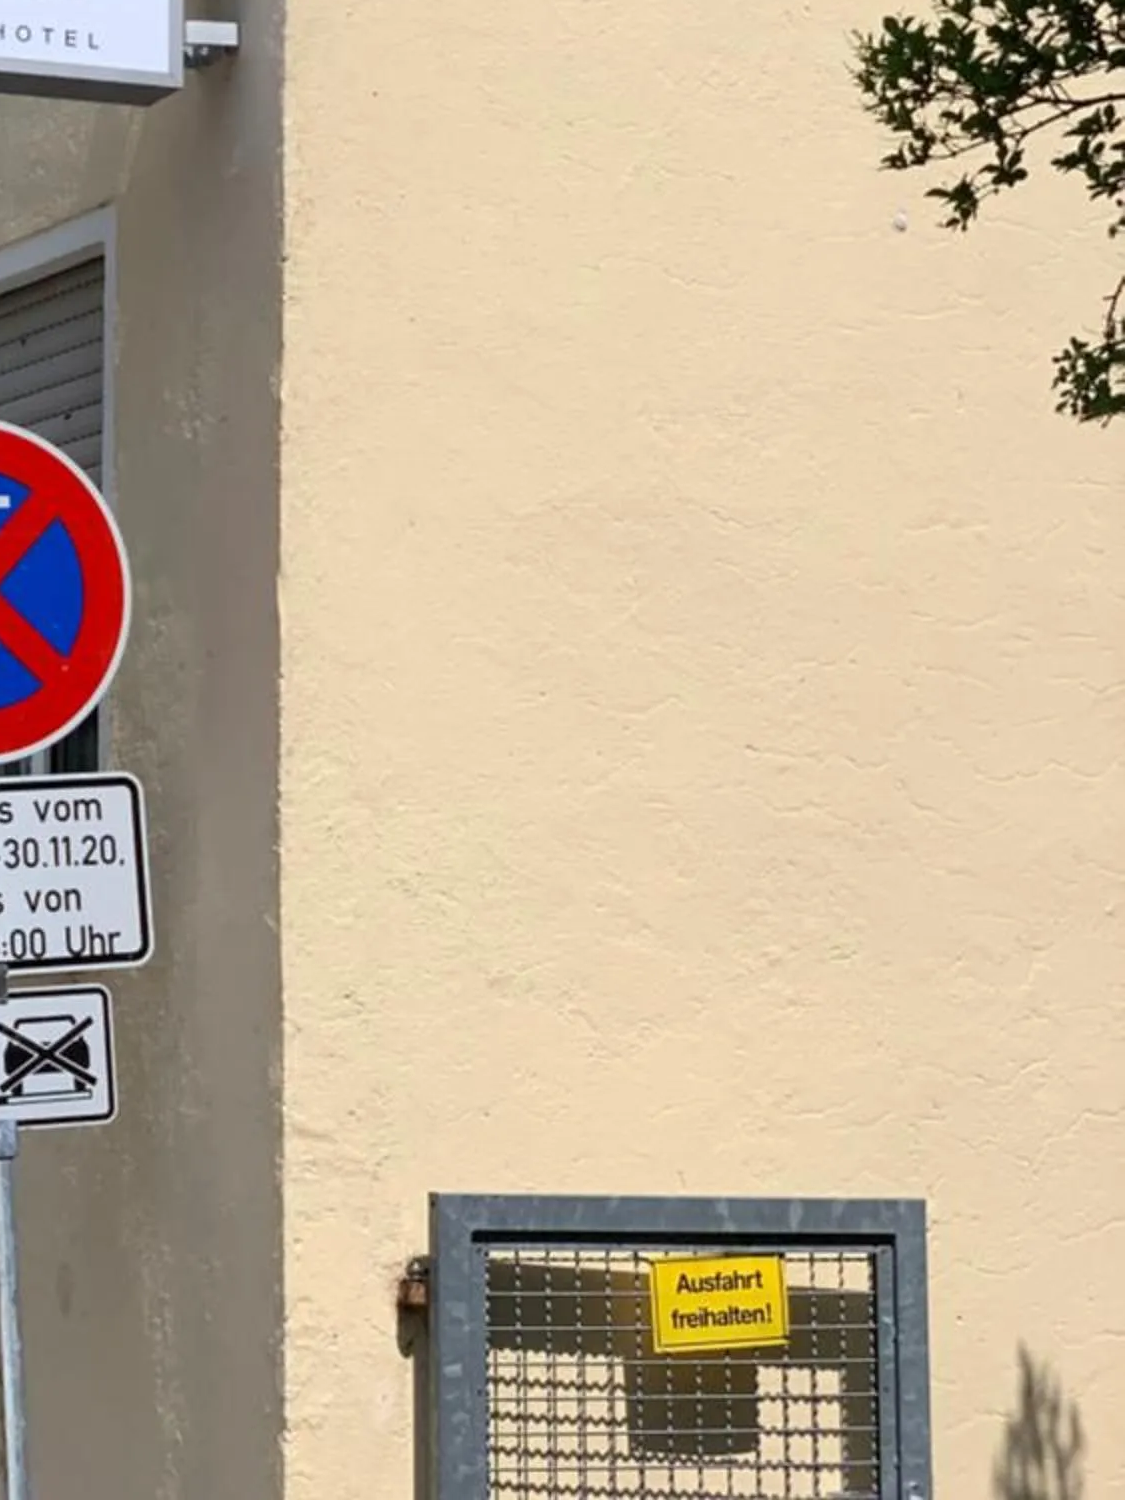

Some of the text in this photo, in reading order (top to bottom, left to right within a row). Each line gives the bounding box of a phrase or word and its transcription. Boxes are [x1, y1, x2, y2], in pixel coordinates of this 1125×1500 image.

[33, 798, 102, 821] vom
[25, 888, 83, 913] von
[64, 926, 122, 957] Uhr
[676, 1269, 763, 1293] Ausfahrt
[671, 1302, 773, 1330] freihalten!
